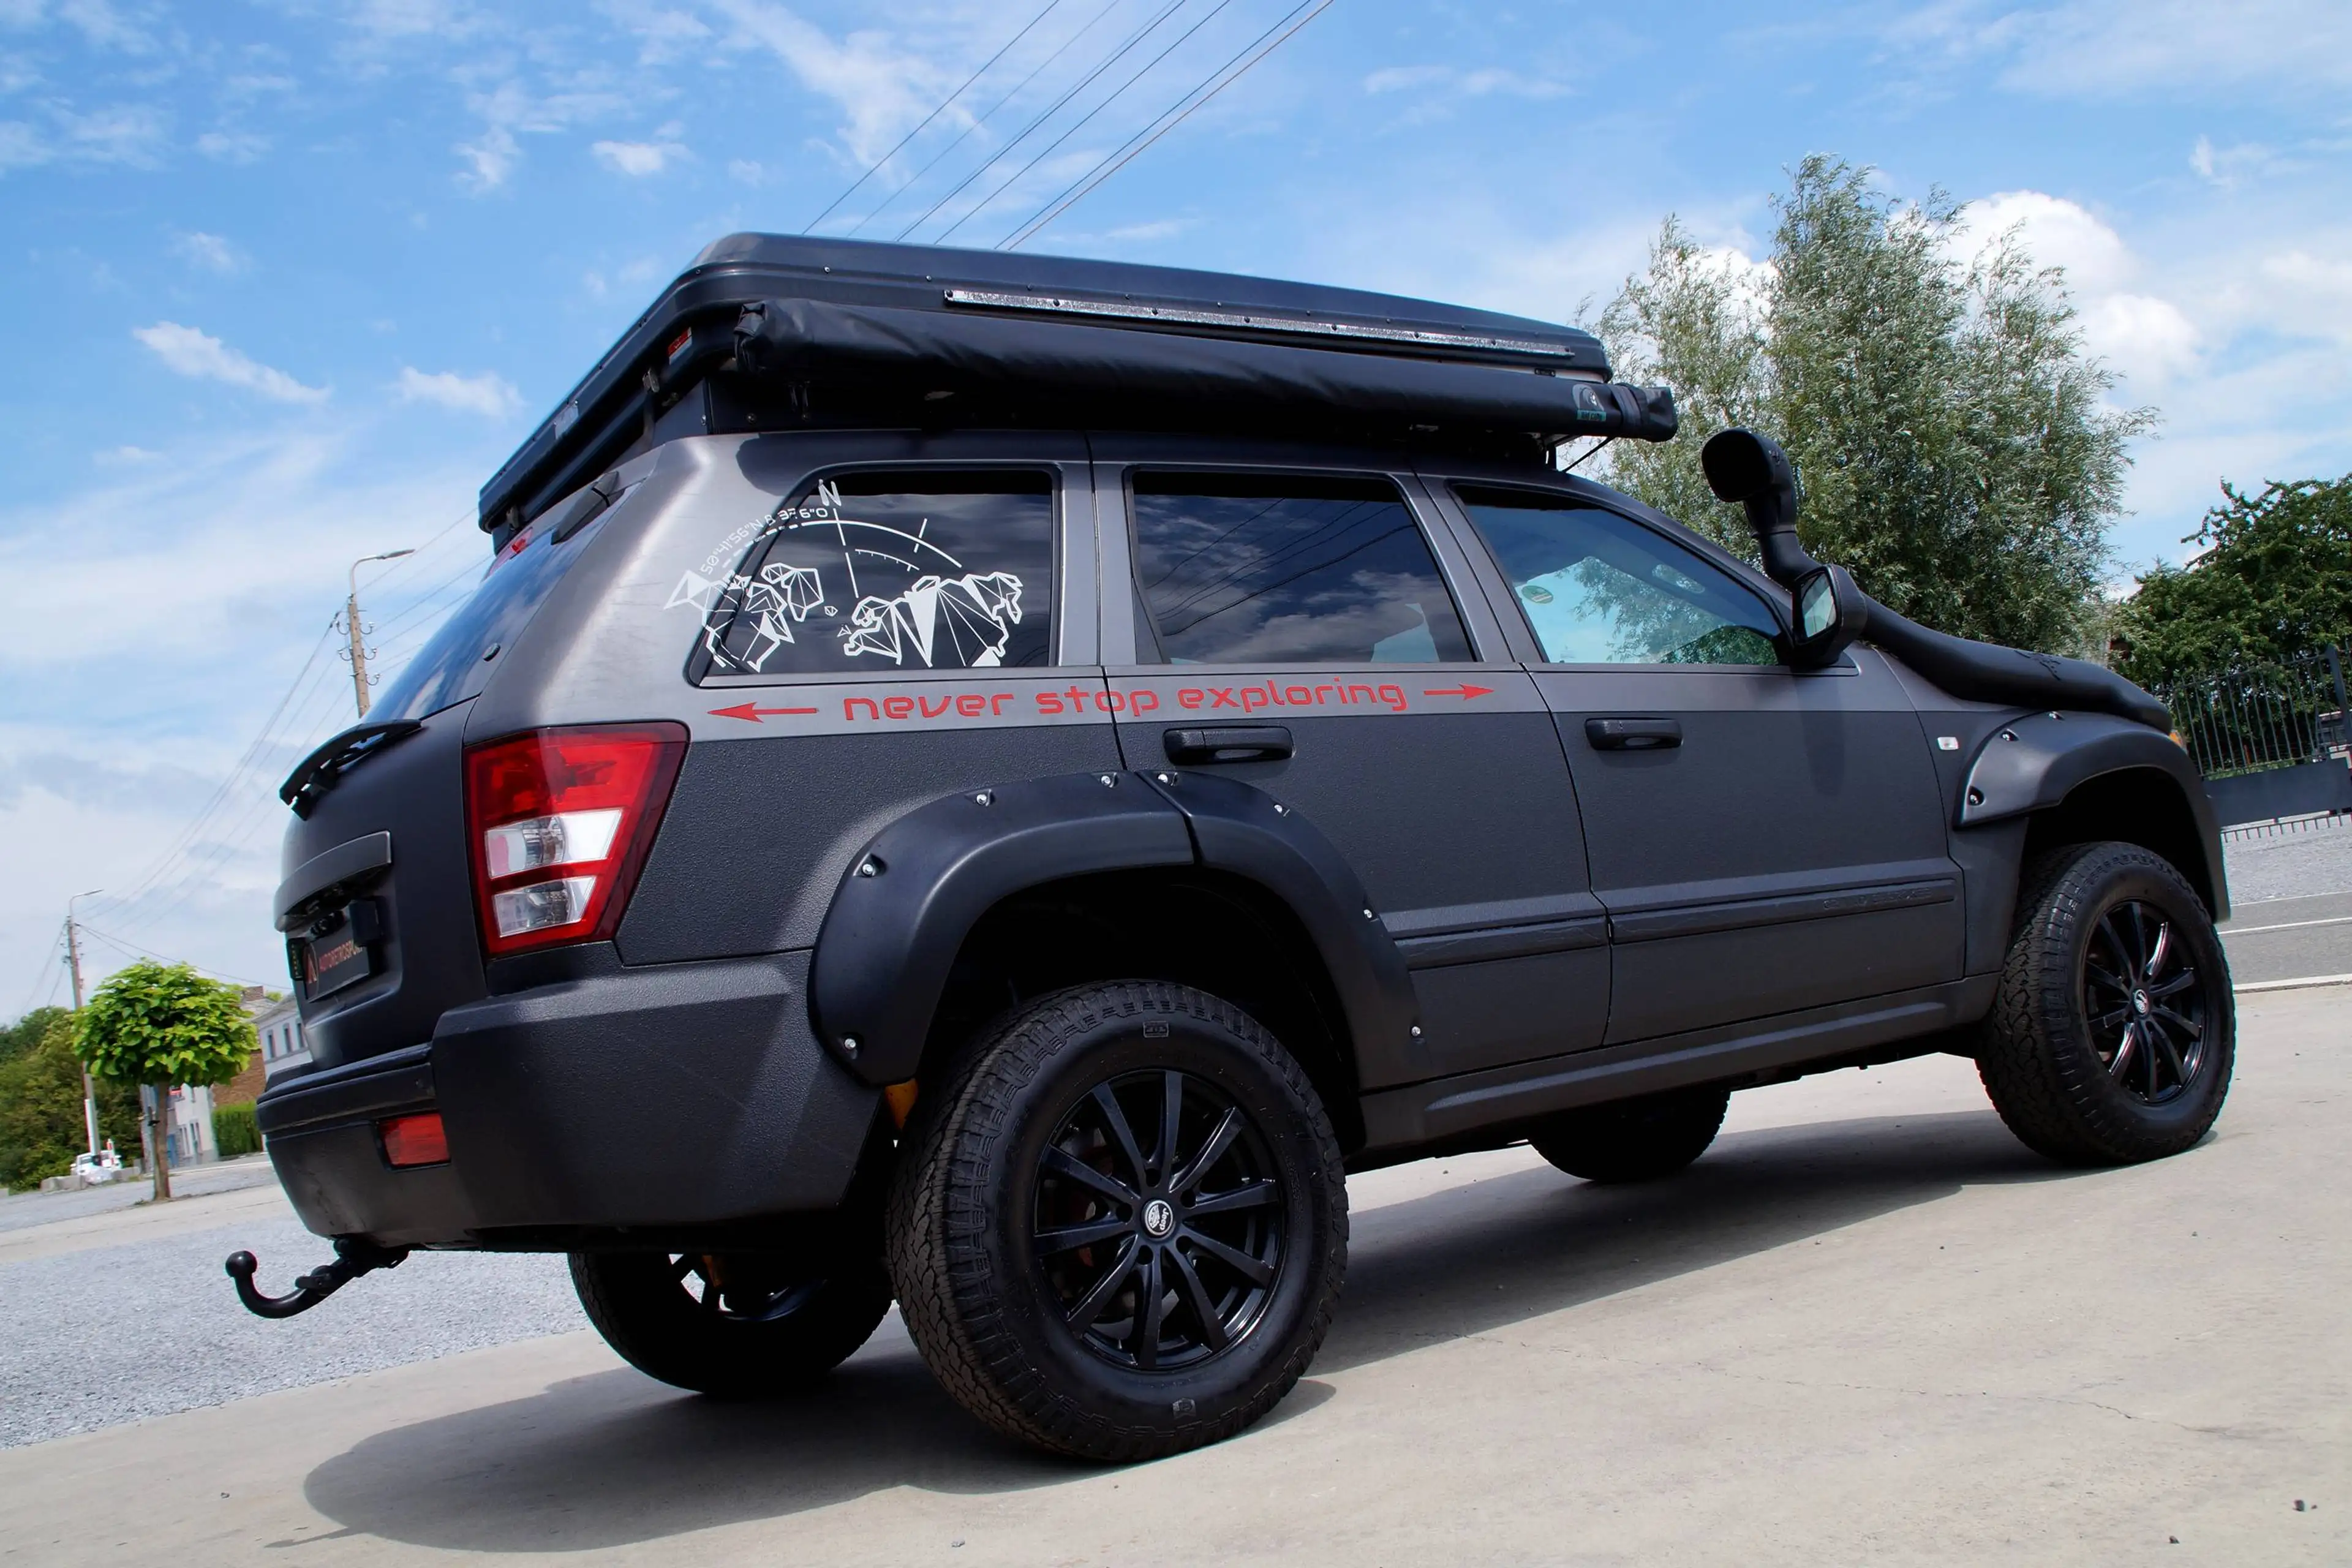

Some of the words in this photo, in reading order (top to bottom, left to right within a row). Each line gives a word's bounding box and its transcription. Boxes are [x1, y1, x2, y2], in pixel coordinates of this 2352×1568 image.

[843, 693, 1014, 720] never
[1035, 685, 1159, 717] stop
[1177, 677, 1408, 713] exploring
[1159, 1208, 1169, 1230] Jeep
